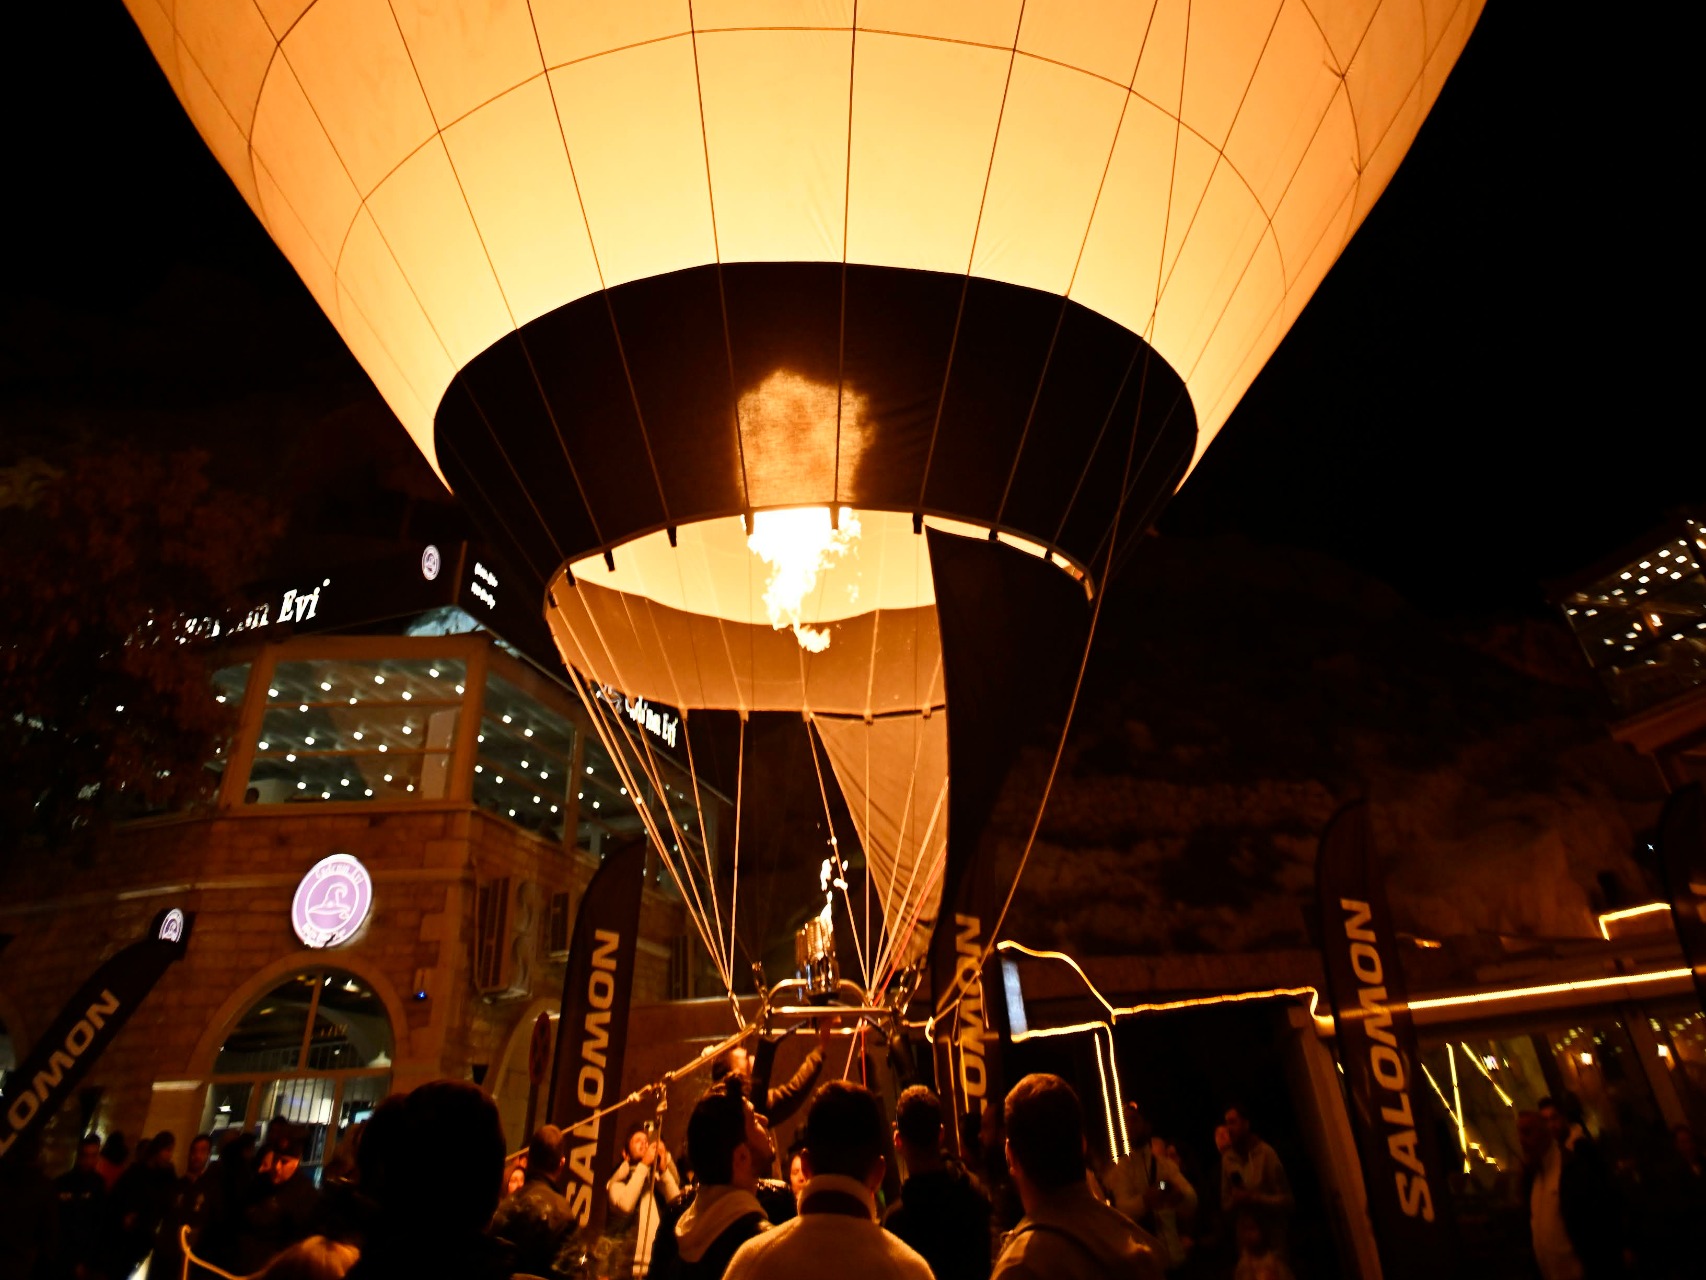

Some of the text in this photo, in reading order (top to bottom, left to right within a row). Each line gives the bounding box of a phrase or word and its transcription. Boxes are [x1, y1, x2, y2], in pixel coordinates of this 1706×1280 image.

[566, 928, 620, 1229] SALOMON
[955, 913, 988, 1116] OMON
[1340, 898, 1435, 1223] SALOMON
